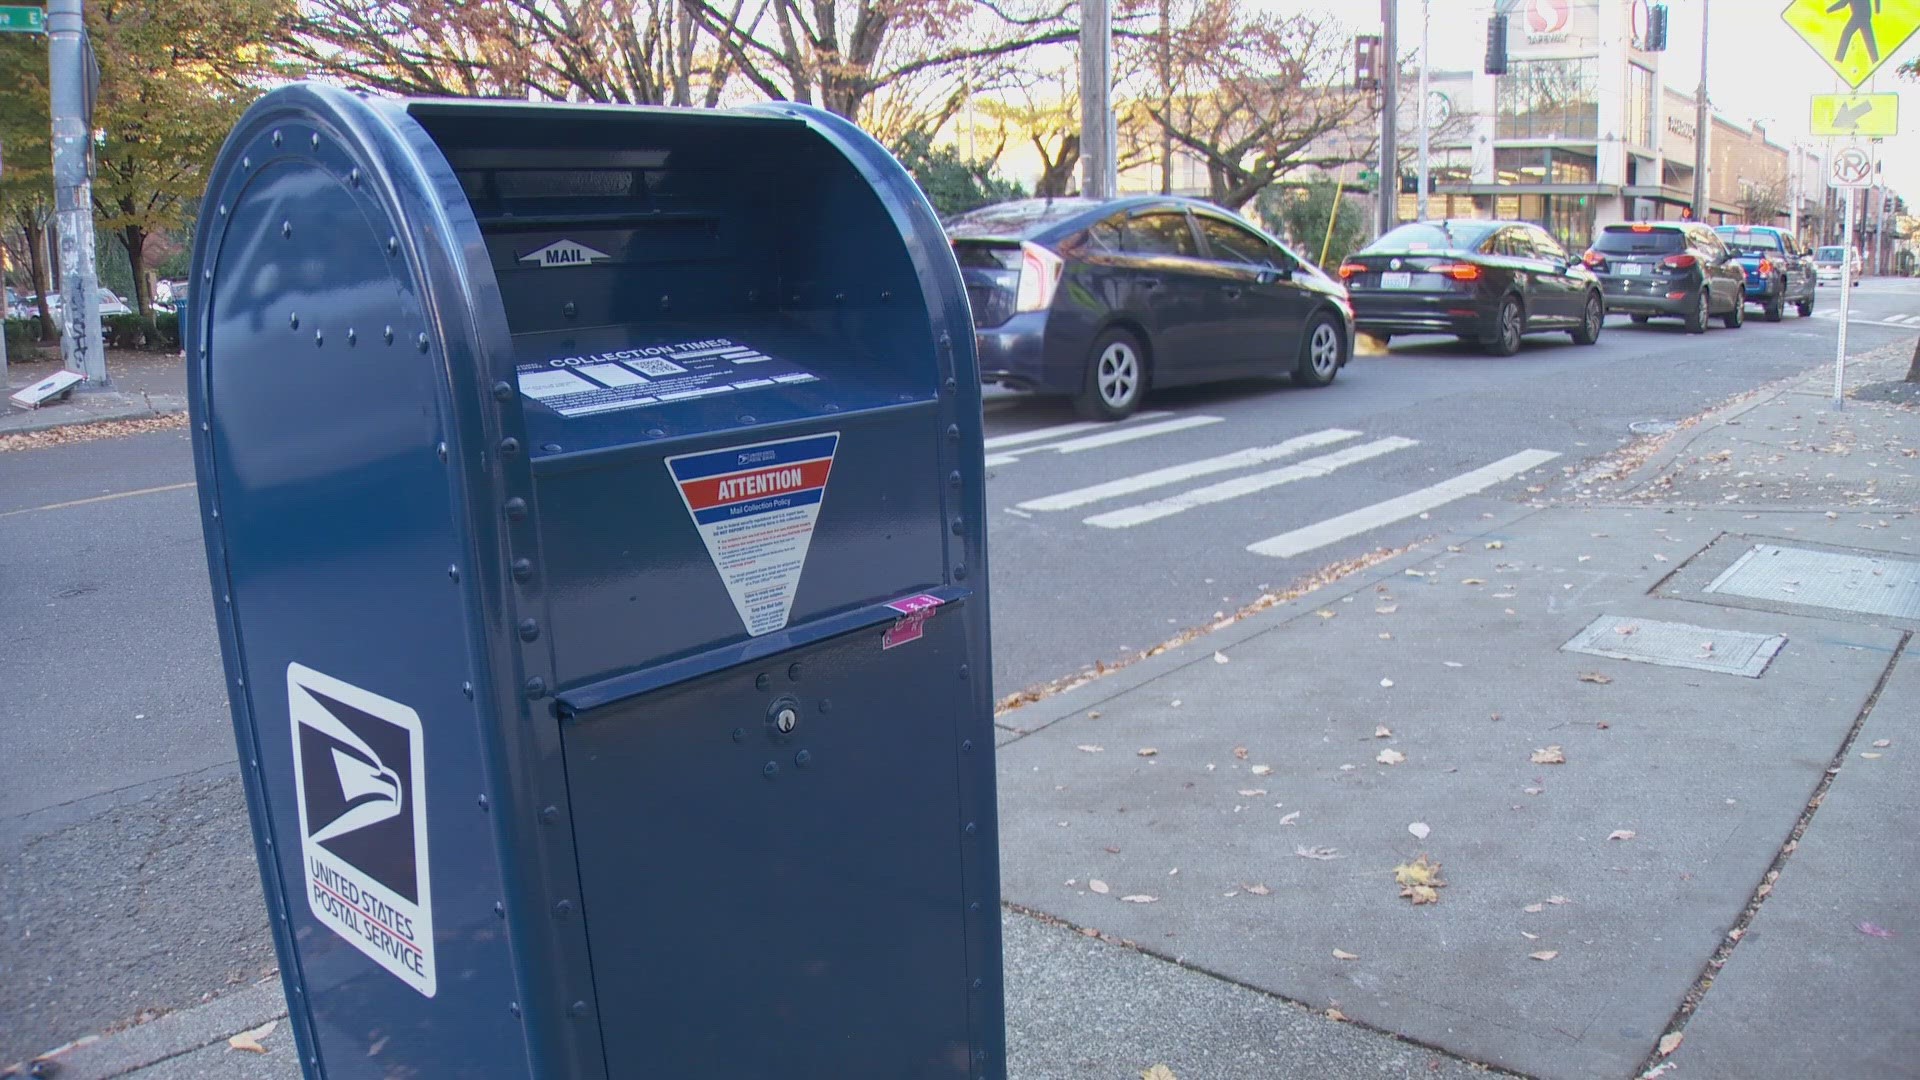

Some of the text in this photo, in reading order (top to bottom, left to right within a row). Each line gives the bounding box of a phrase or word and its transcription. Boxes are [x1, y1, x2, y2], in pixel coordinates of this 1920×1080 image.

[29, 12, 39, 24] E
[546, 249, 585, 264] MAIL
[549, 346, 675, 368] COLLECTION
[674, 338, 732, 351] TIMES
[718, 467, 802, 501] ATTENTION
[730, 498, 791, 515] Mail Collection Policy
[310, 856, 414, 941] UNITED STATES
[313, 884, 425, 978] POSTAL SERVICE
